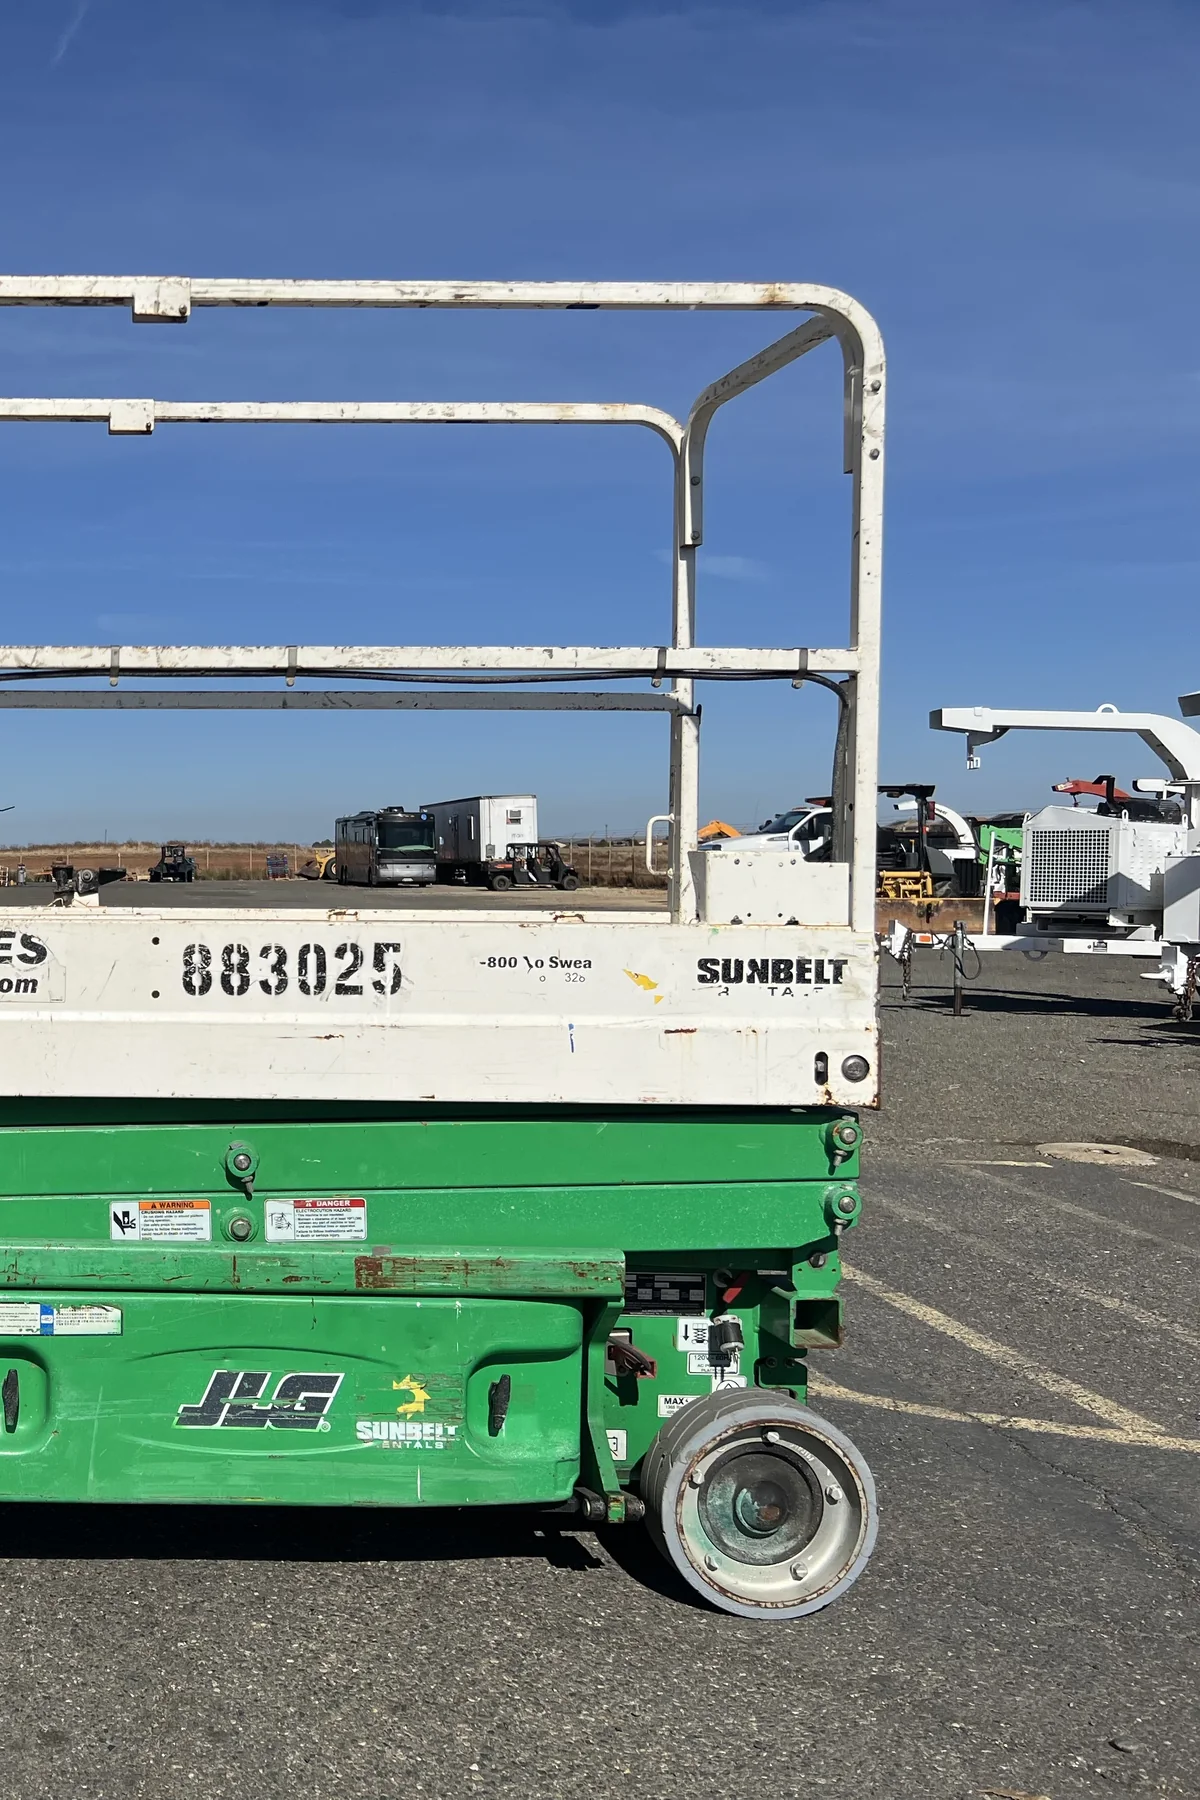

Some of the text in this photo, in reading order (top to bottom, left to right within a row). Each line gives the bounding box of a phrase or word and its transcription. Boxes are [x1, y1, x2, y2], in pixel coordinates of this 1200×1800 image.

[181, 941, 402, 996] 883025
[697, 958, 849, 985] SUNBELT
[171, 1369, 346, 1431] JLG
[663, 1397, 684, 1405] MAX
[356, 1421, 459, 1442] SUNBELT
[377, 1441, 444, 1450] ENTALS
